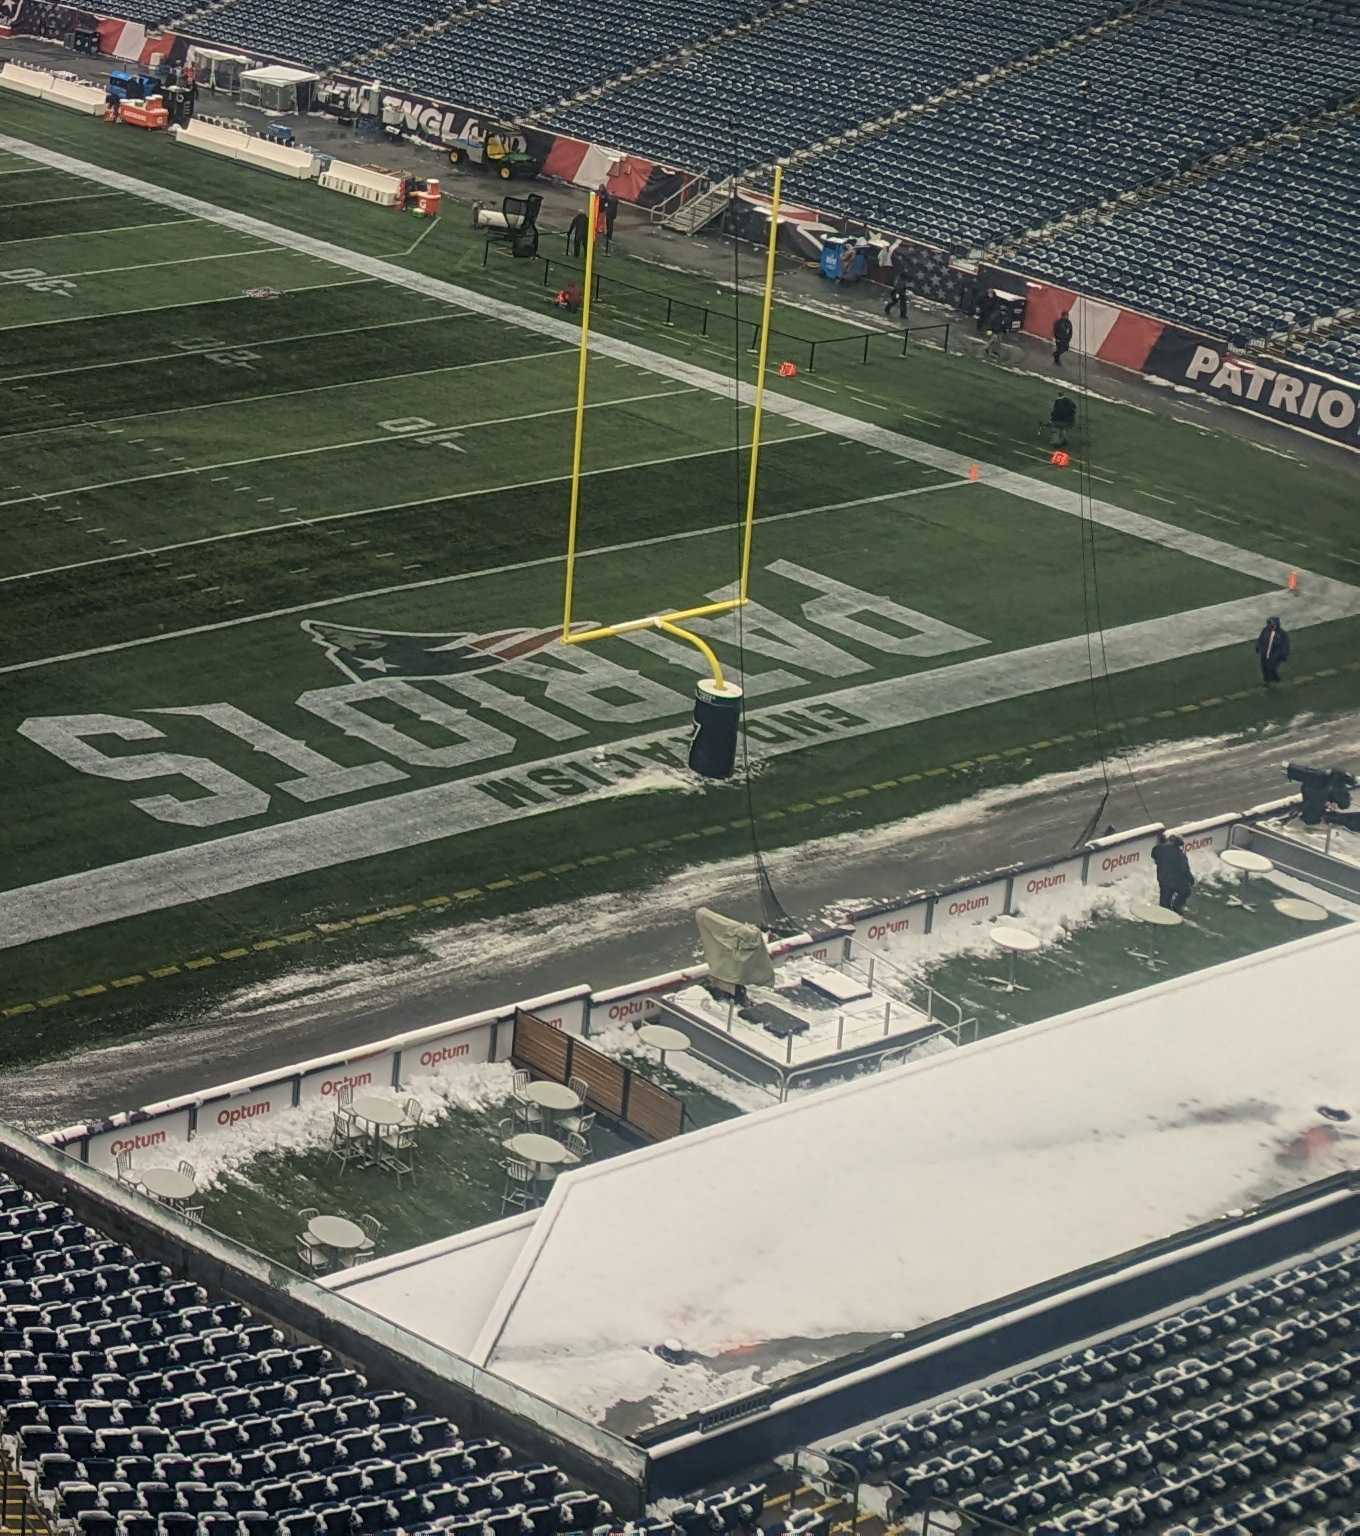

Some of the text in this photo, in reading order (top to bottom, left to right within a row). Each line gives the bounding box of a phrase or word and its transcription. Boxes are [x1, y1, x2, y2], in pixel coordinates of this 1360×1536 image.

[172, 337, 263, 366] 20
[1184, 345, 1360, 430] PATRIO
[17, 558, 993, 830] PATRIOTS
[743, 701, 870, 744] END
[1102, 850, 1141, 873] Optum
[1027, 870, 1067, 894] Optum
[949, 894, 990, 917] Optum
[419, 1041, 471, 1069] Optum
[320, 1069, 372, 1097] Optum
[217, 1099, 271, 1127] Optum
[110, 1130, 167, 1157] Optum
